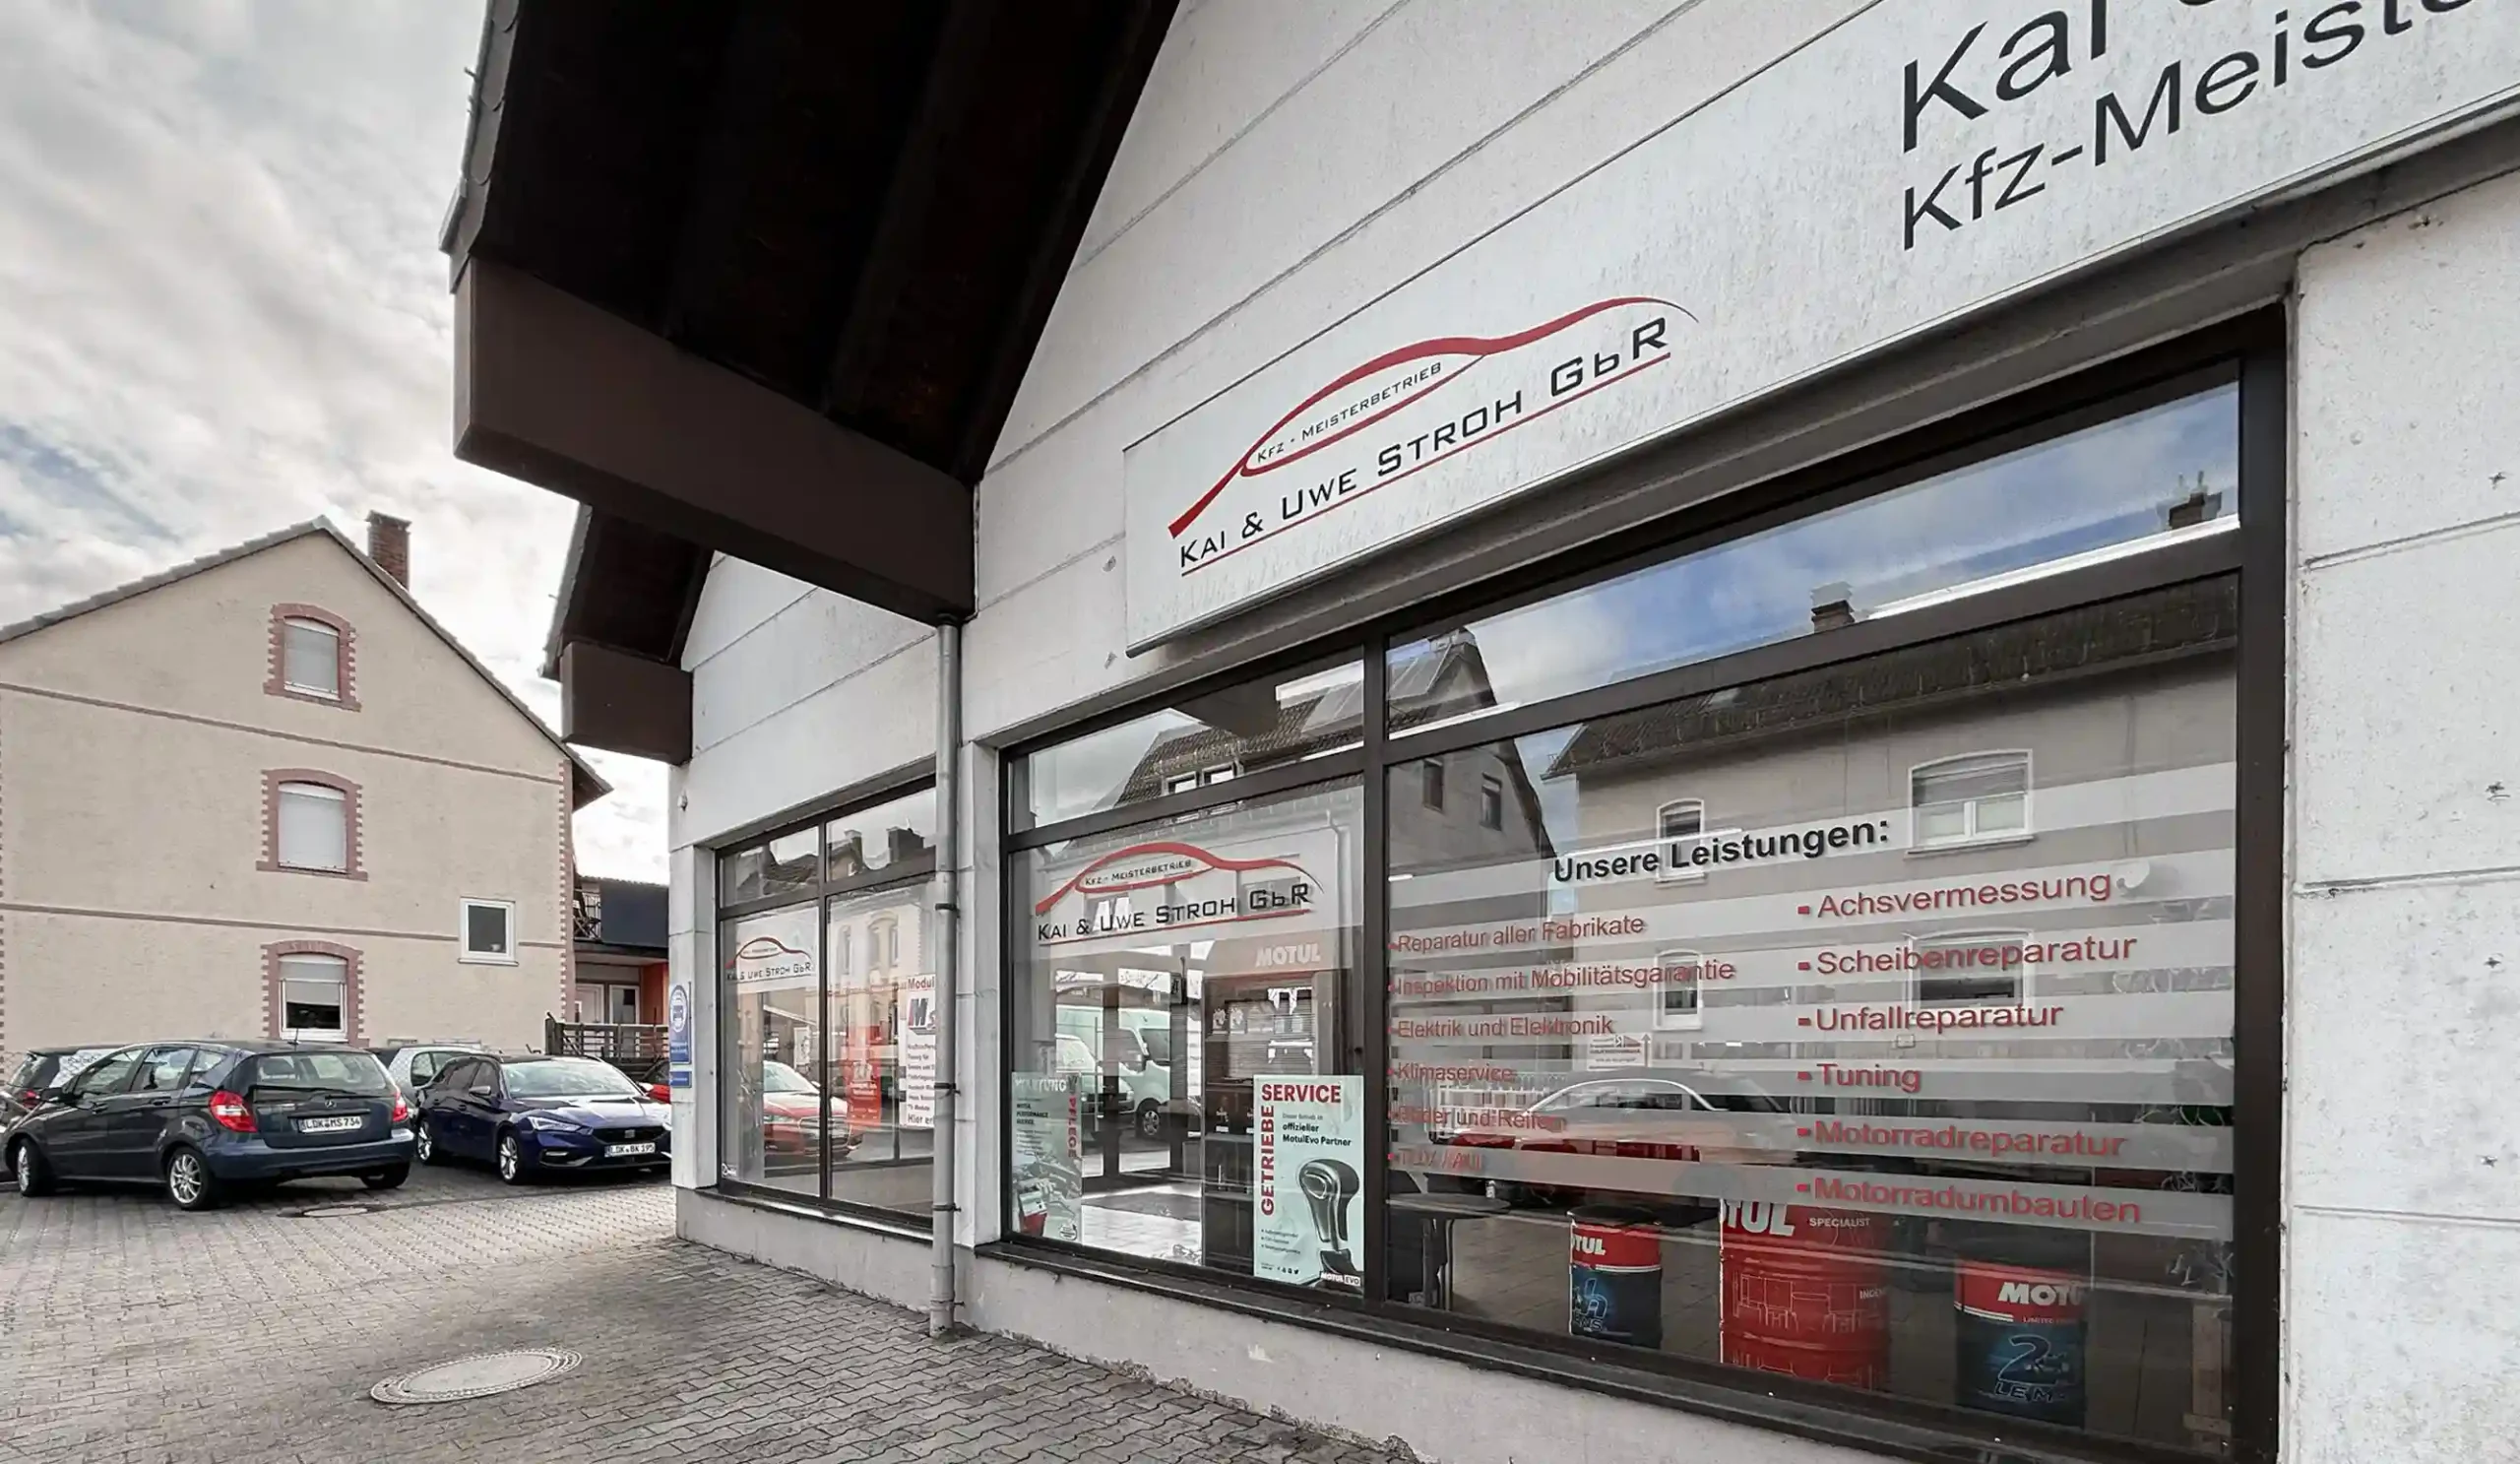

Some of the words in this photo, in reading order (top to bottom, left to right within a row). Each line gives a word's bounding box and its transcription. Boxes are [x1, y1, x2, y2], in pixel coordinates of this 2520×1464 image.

[1301, 361, 1442, 442] MEISTERBETRIEB
[1180, 530, 1226, 568] KAI
[1241, 511, 1265, 540] &
[1282, 467, 1357, 521] UWE
[1377, 390, 1522, 477] STROH
[1550, 317, 1670, 398] GbR
[1553, 851, 1660, 883] Unsere
[1670, 819, 1889, 869] Leistungen:
[1037, 923, 1068, 941] KAI
[1075, 918, 1090, 936] &
[1100, 912, 1145, 932] UWE
[1155, 897, 1235, 924] STROH
[1249, 882, 1309, 911] GbR
[1816, 870, 2112, 920] Achsvermessung
[1396, 929, 1492, 954] Reparatur
[1492, 923, 1536, 947] aller
[1542, 914, 1647, 942] Fabrikate
[1255, 941, 1322, 969] MOTUL
[1816, 934, 2139, 975] Scheibenreparatur
[1396, 970, 1489, 997] Inspektion
[1494, 968, 1527, 991] mit
[1531, 958, 1737, 989] Mobilitätsgarantie
[1397, 1018, 1462, 1039] Elektrik
[1468, 1014, 1506, 1037] und
[1510, 1013, 1615, 1037] Elektronik
[1815, 1002, 2065, 1034] Unfallreparatur
[1397, 1061, 1517, 1082] Klimaservice
[1815, 1062, 1923, 1094] Tuning
[1261, 1083, 1342, 1104] SERVICE
[1282, 1122, 1320, 1132] offizieller
[1456, 1107, 1493, 1127] und
[1320, 1135, 1353, 1147] Partner
[1813, 1119, 2129, 1158] Motorradreparatur
[1260, 1105, 1275, 1216] GETRIEBE
[1719, 1201, 1796, 1238] TUL
[1813, 1177, 2143, 1224] Motorradumbauten
[1808, 1216, 1871, 1229] SPECIALIST
